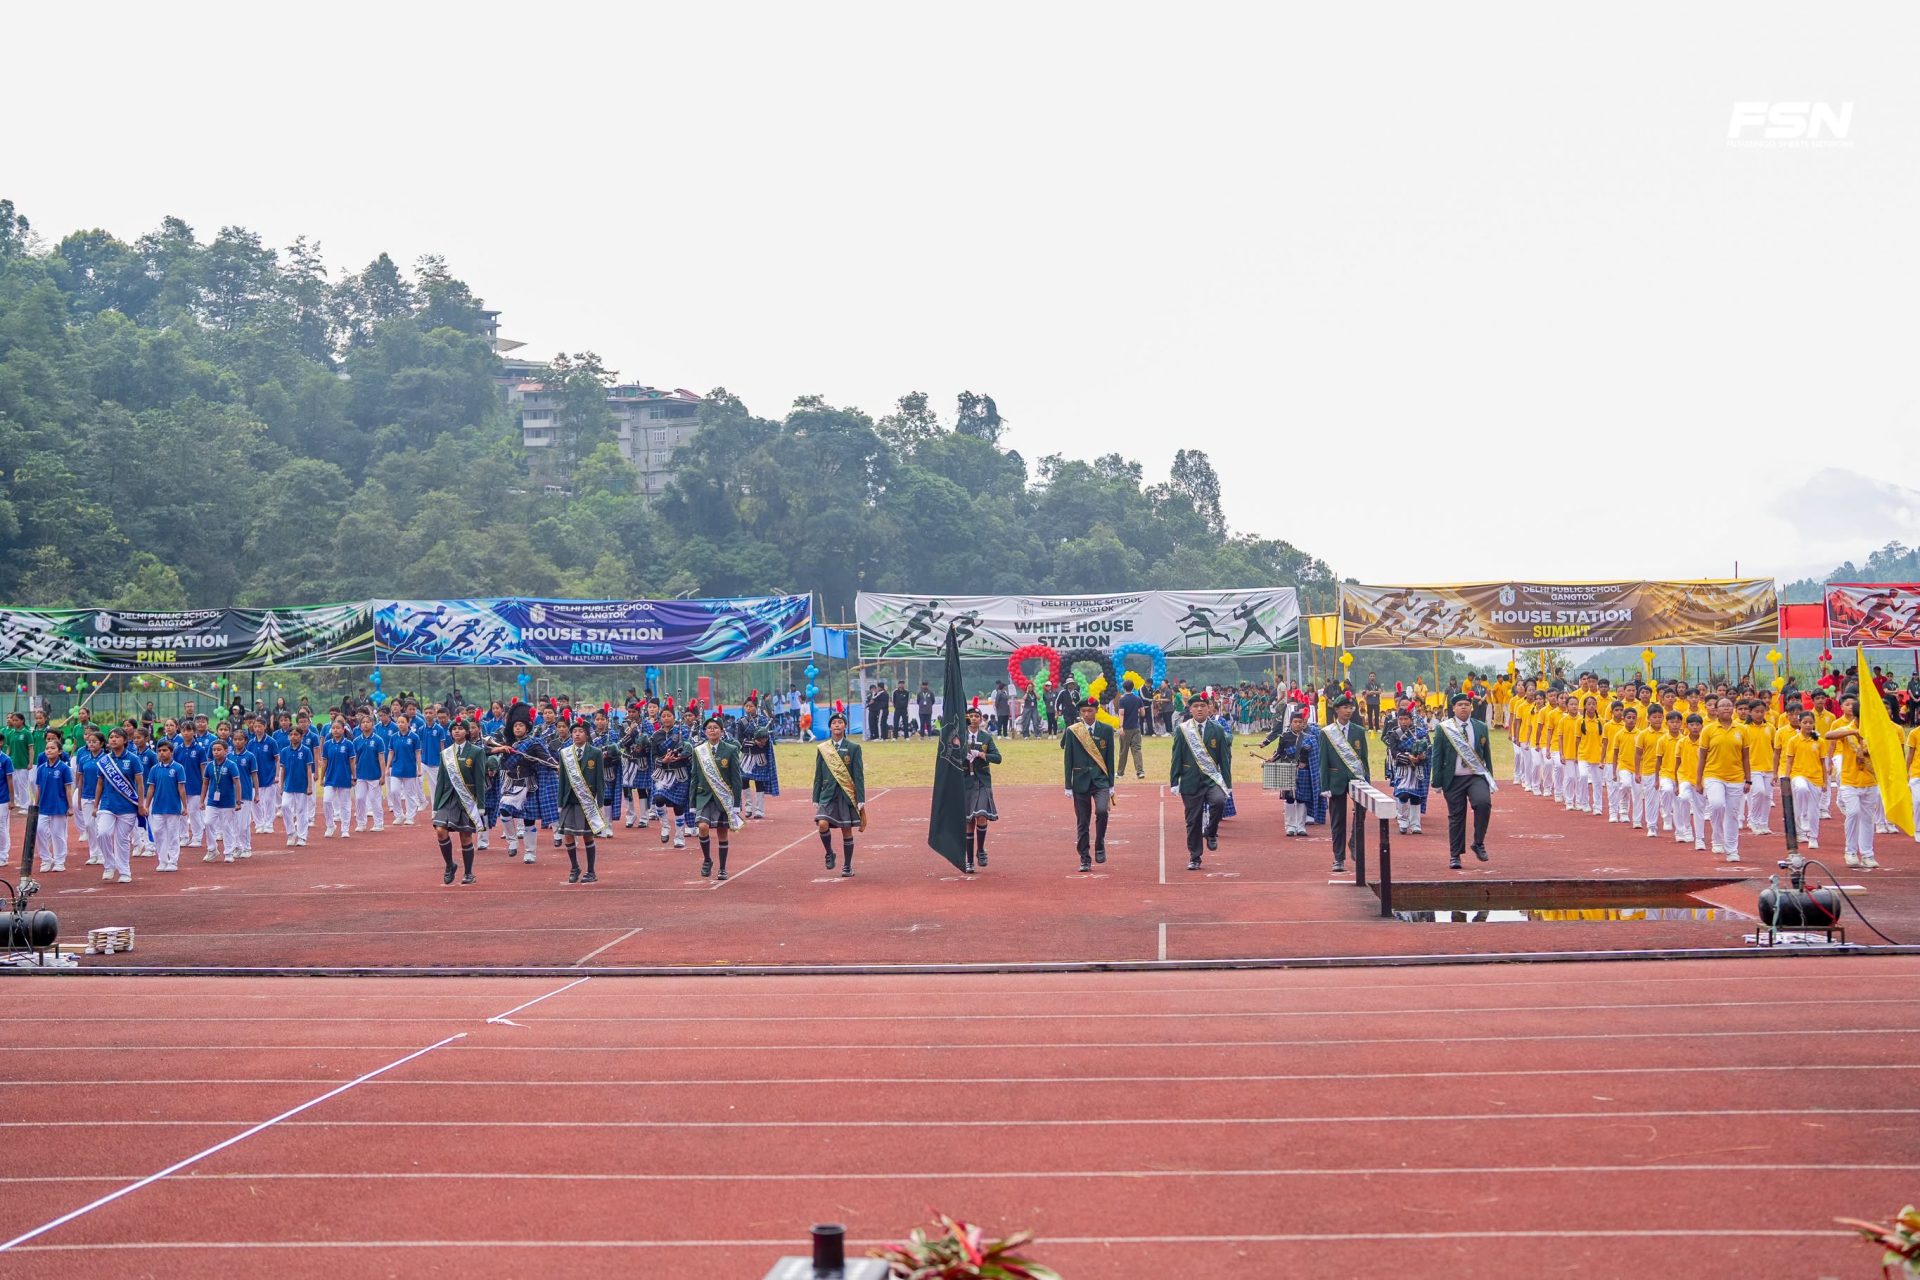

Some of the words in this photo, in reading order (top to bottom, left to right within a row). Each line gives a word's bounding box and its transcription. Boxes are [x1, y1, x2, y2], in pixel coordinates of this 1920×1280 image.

[1585, 585, 1623, 593] SCHOOL
[1070, 599, 1102, 607] PUBLIC
[1105, 597, 1143, 606] SCHOOL
[1551, 593, 1595, 601] GANGTOK
[617, 603, 655, 611] SCHOOL
[1070, 605, 1115, 614] GANGTOK
[119, 612, 148, 620] DELHI
[148, 611, 182, 619] PUBLIC
[183, 610, 222, 619] SCHOOL
[582, 611, 627, 619] GANGTOK
[1490, 610, 1552, 624] HOUSE
[1556, 608, 1633, 623] STATION
[148, 619, 194, 627] GANGTOK
[1014, 621, 1071, 634] WHITE
[1076, 620, 1134, 633] HOUSE
[521, 627, 582, 640] HOUSE
[586, 627, 663, 641] STATION
[1533, 625, 1591, 638] SUMMIT
[85, 635, 148, 649] HOUSE
[151, 634, 229, 648] STATION
[1037, 635, 1110, 648] STATION
[570, 642, 614, 655] AQUA
[136, 650, 177, 663] PINE
[104, 762, 117, 778] VICE
[112, 775, 133, 797] CAPTAIN
